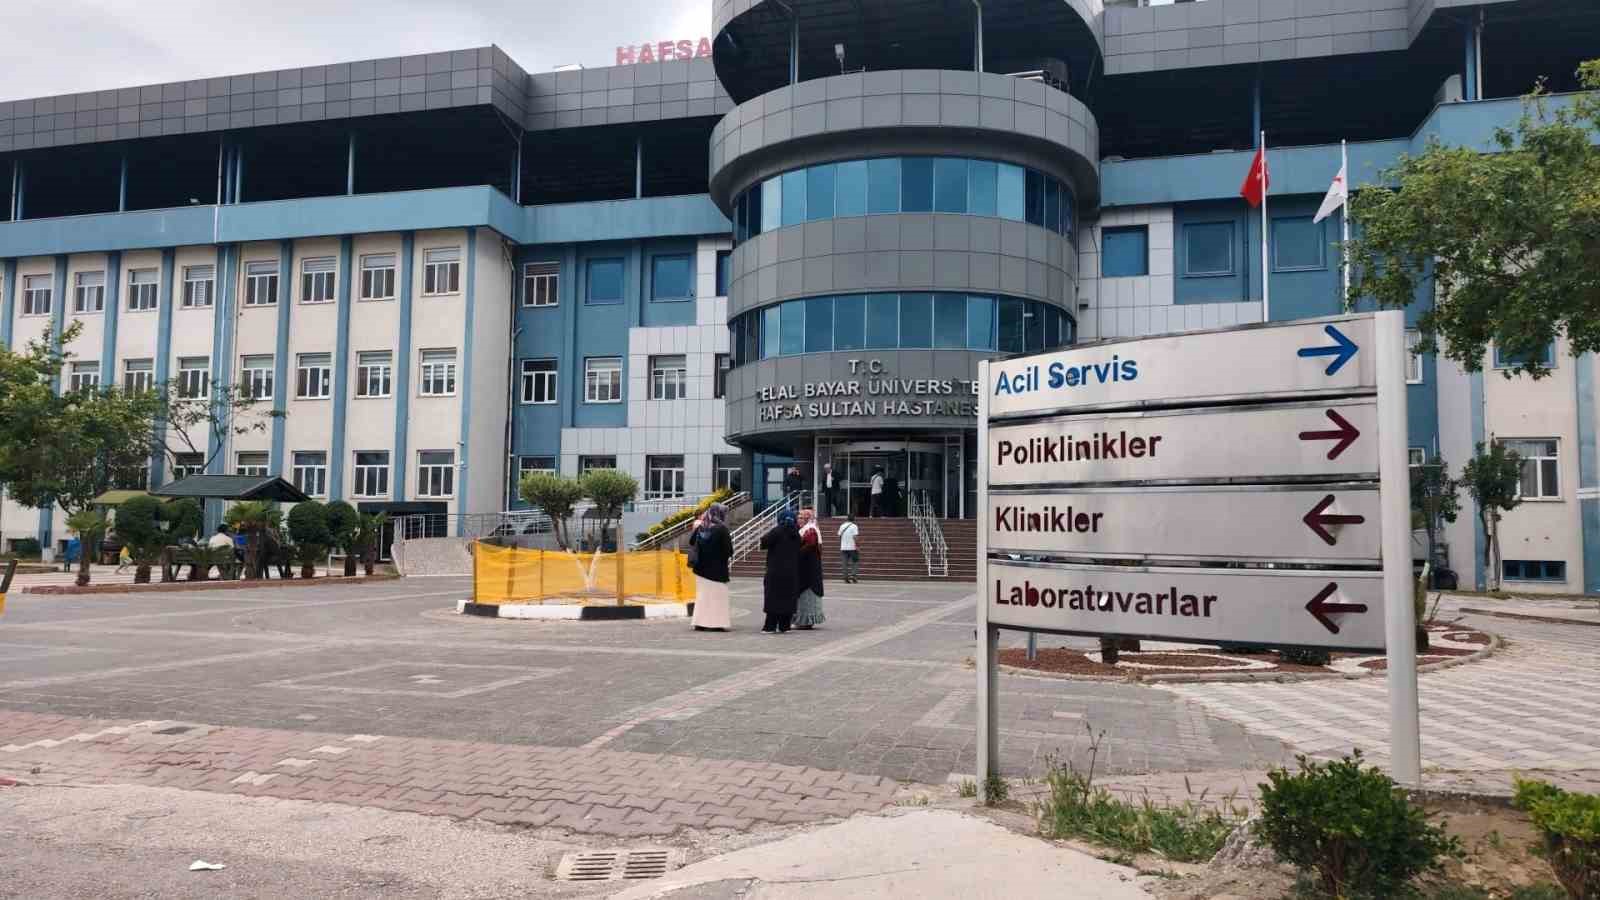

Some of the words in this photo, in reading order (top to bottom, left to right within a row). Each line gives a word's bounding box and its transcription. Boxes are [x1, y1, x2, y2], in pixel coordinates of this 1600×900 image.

[615, 37, 712, 64] HAFSA
[995, 365, 1039, 396] Acil
[1048, 355, 1138, 389] Servis
[756, 384, 797, 401] ELAL
[804, 381, 860, 397] BAYAR
[760, 403, 803, 420] HAFSA
[808, 400, 876, 417] SULTAN
[998, 431, 1162, 466] Poliklinikler
[995, 506, 1104, 533] Klinikler
[995, 580, 1217, 617] Laboratuvarlar
